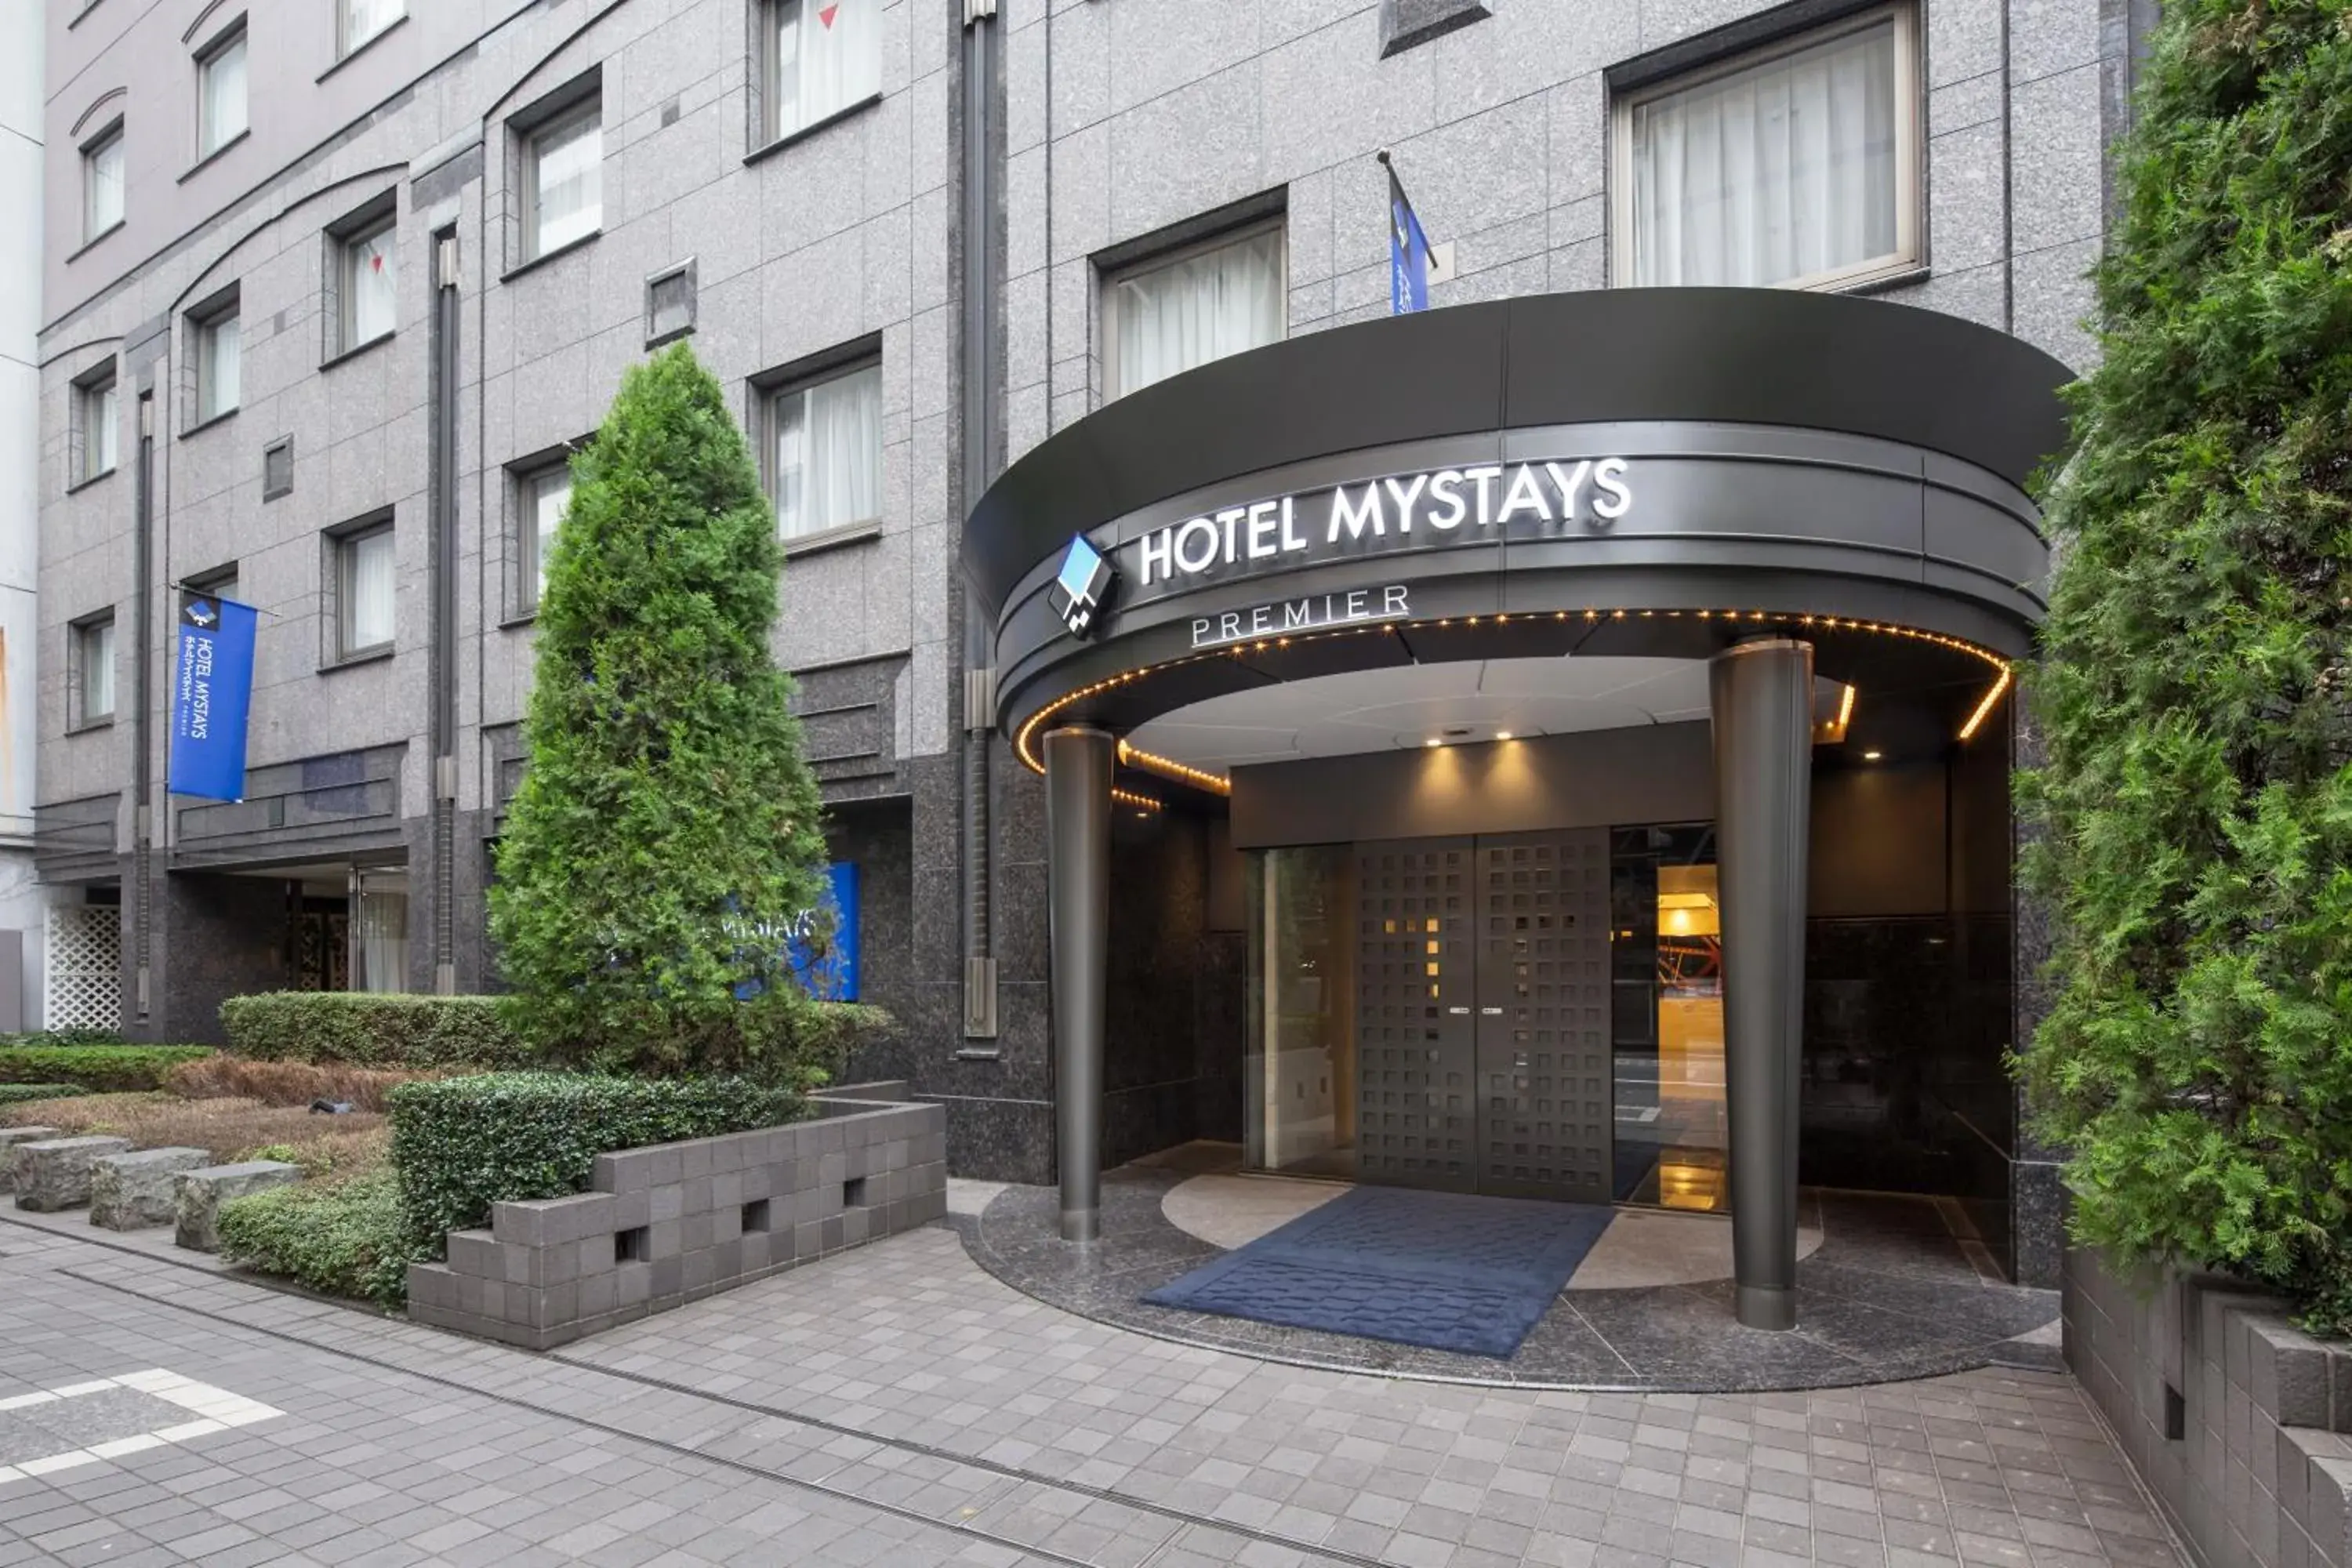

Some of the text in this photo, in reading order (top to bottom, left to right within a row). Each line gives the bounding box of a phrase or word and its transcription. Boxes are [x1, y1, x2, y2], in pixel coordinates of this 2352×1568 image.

[1140, 457, 1632, 585] HOTEL MYSTAYS
[1191, 584, 1410, 645] PREMIER
[191, 637, 213, 739] HOTEL MYSTAYS
